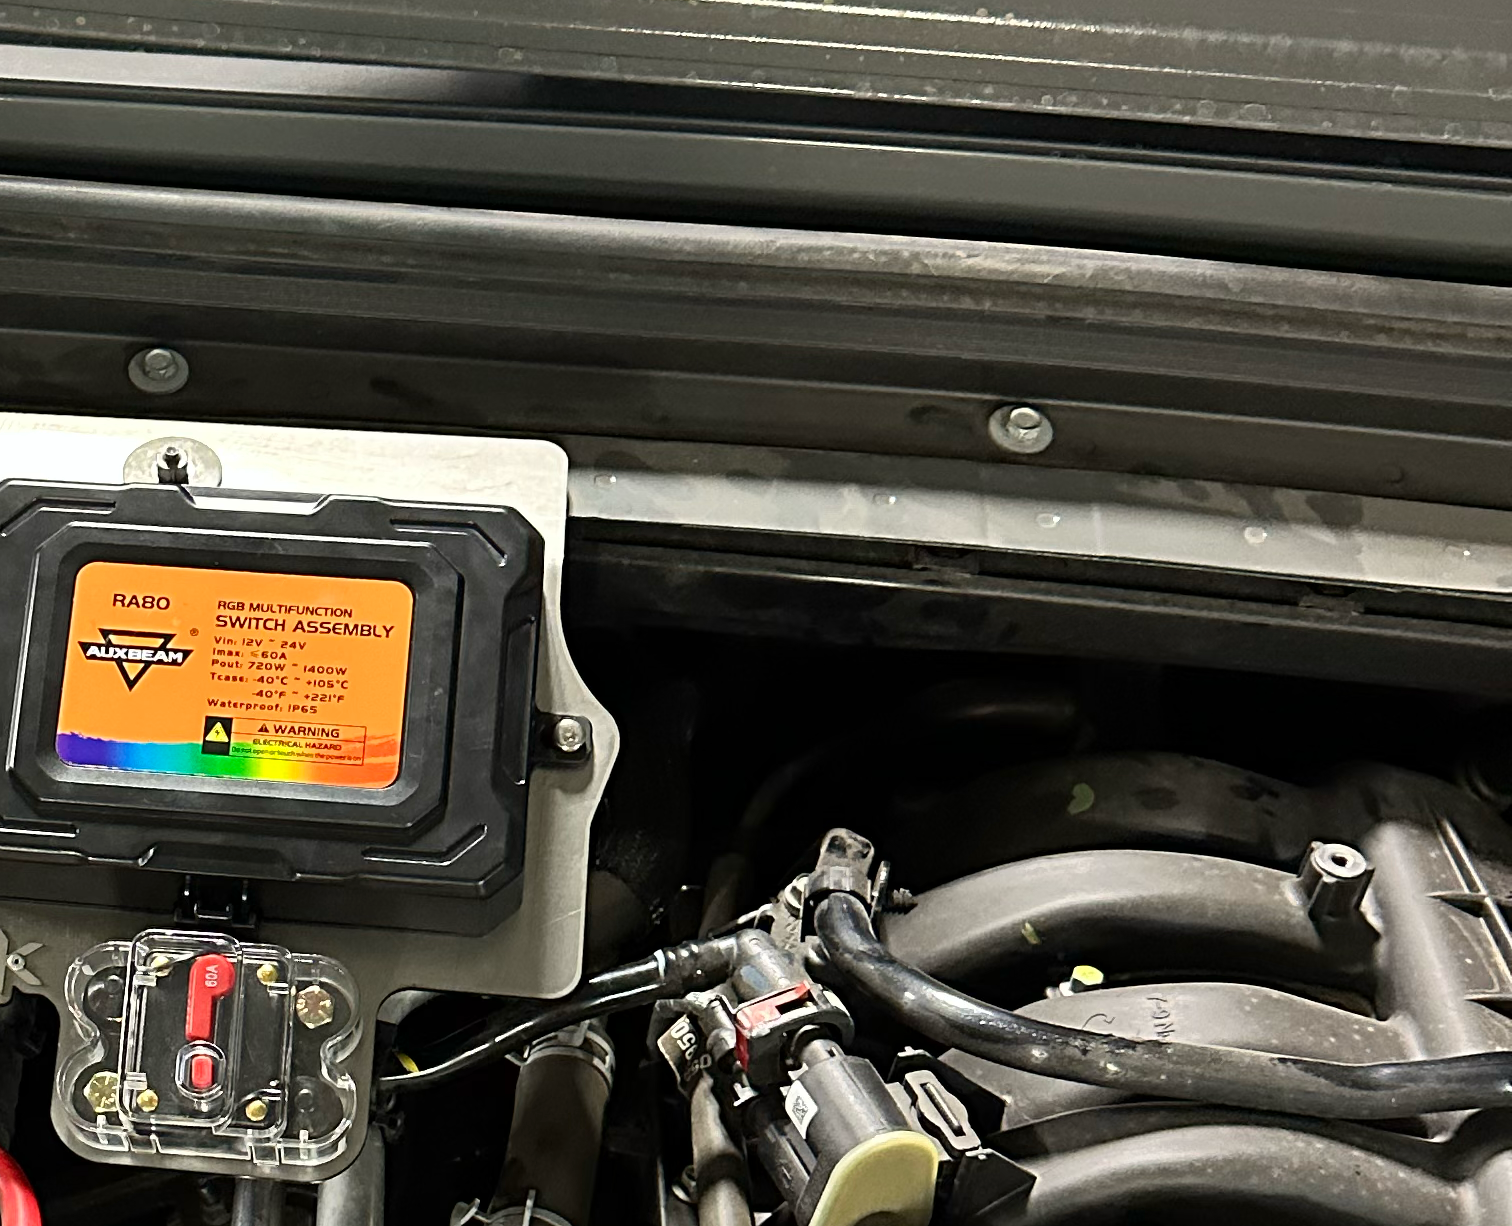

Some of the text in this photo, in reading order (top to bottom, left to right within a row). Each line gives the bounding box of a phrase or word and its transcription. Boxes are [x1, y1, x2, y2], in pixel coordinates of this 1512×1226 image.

[217, 600, 353, 618] RGB MULTIFUNCTION
[215, 614, 394, 638] SWITCH ASSEMBLY
[242, 638, 264, 647] 12V
[280, 641, 307, 650] 24V
[86, 645, 183, 663] AUXBEAM
[211, 659, 243, 669] Pout:
[248, 661, 286, 672] 720W
[303, 665, 348, 676] 1400W
[210, 672, 248, 683] Tcase:
[253, 675, 288, 686] -40°C
[306, 679, 349, 690] +105°C
[252, 689, 287, 699] -40°F
[304, 693, 345, 703] +221°F
[207, 698, 318, 714] Waterproof: IP65
[273, 724, 340, 738] WARNING
[253, 738, 342, 751] ELECTRICAL HAZARD
[205, 964, 219, 988] 60A
